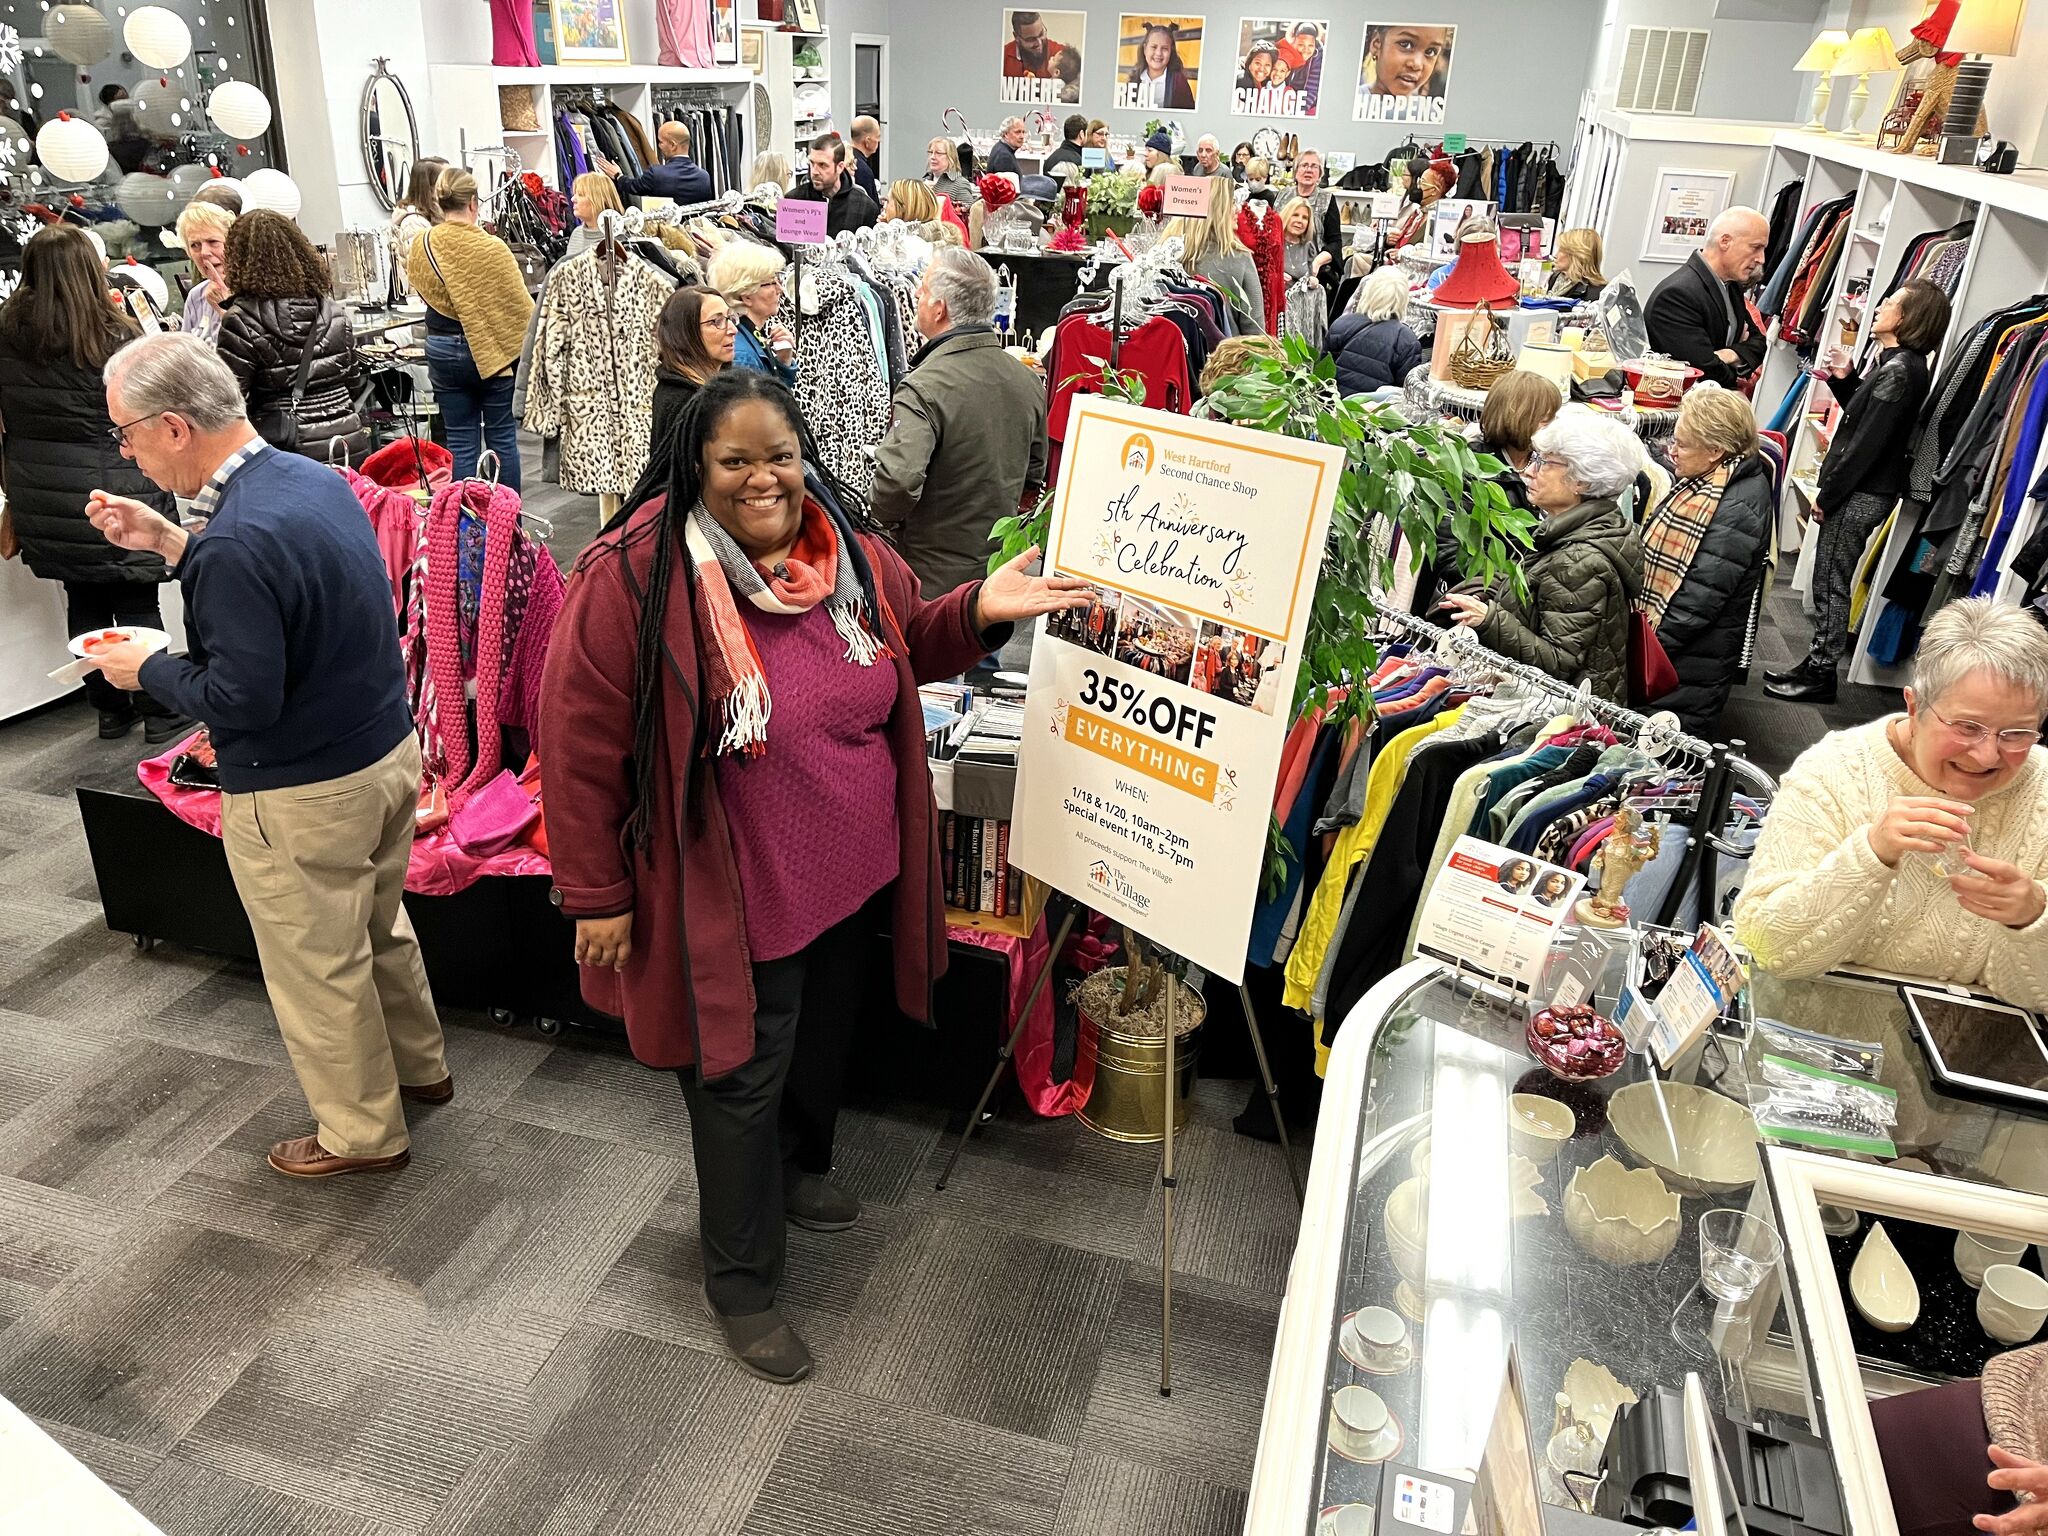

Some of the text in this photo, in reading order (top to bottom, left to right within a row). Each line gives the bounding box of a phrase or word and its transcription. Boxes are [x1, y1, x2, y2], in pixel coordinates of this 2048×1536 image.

[1000, 76, 1063, 104] WHERE
[1114, 82, 1159, 109] REAL
[1231, 86, 1307, 117] CHANGE
[1355, 93, 1445, 124] HAPPENS
[1170, 185, 1202, 194] Women's
[1172, 197, 1198, 205] Dresses
[782, 206, 810, 214] Women's
[780, 227, 802, 236] Lounge
[1164, 449, 1231, 475] West Hartford
[1159, 463, 1258, 499] Second Chance Shop
[1103, 484, 1250, 575] 5th Anniversary
[1116, 539, 1223, 590] Celebration
[1075, 717, 1207, 788] EVERYTHING
[1072, 786, 1093, 804] 1/18
[1094, 797, 1102, 809] &
[1105, 802, 1128, 823] 1/20,
[1115, 778, 1149, 804] WHEN:
[971, 828, 980, 854] BROKER
[1063, 798, 1097, 823] Special
[1099, 817, 1129, 839] event
[1131, 831, 1155, 853] 1/18,
[984, 821, 994, 870] DAVID BALDACCI
[1075, 831, 1173, 884] All proceeds support The Village
[1113, 867, 1126, 881] The
[1115, 877, 1151, 909] Village
